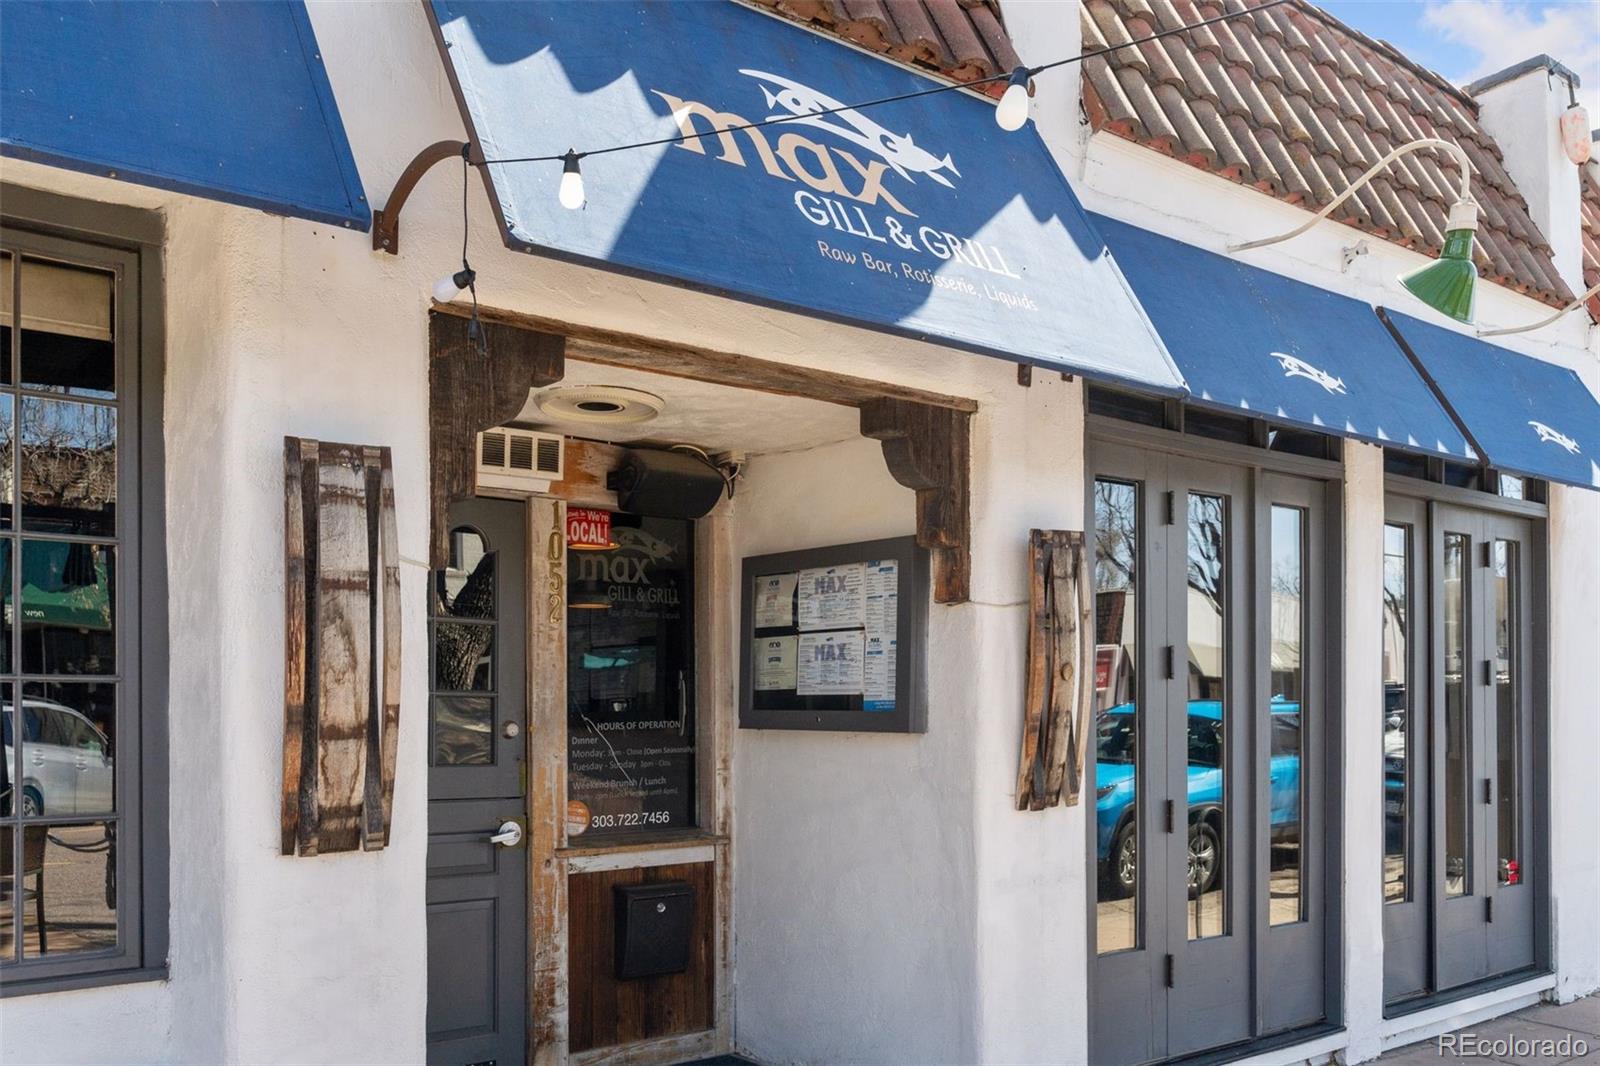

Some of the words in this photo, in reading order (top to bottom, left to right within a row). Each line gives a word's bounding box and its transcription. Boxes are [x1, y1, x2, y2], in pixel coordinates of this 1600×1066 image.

[650, 88, 919, 218] max
[794, 190, 887, 243] GILL
[885, 216, 921, 253] &
[919, 226, 1021, 279] GRILL
[817, 240, 856, 265] Raw
[861, 252, 898, 278] Bar,
[901, 262, 982, 299] Rotisserie,
[984, 285, 1039, 312] Liquids
[548, 500, 563, 624] 1052
[576, 553, 651, 584] max
[814, 574, 848, 595] MAX
[608, 585, 634, 602] GILL
[636, 586, 646, 602] &
[648, 587, 680, 604] GRILL
[814, 643, 848, 661] MAX
[597, 722, 625, 731] HOURS
[626, 721, 637, 730] OF
[638, 720, 681, 729] OPERATION
[572, 737, 598, 745] Dinner
[572, 761, 603, 771] Tuesday
[645, 776, 666, 785] Lunch
[592, 811, 670, 828] 303.722.7456
